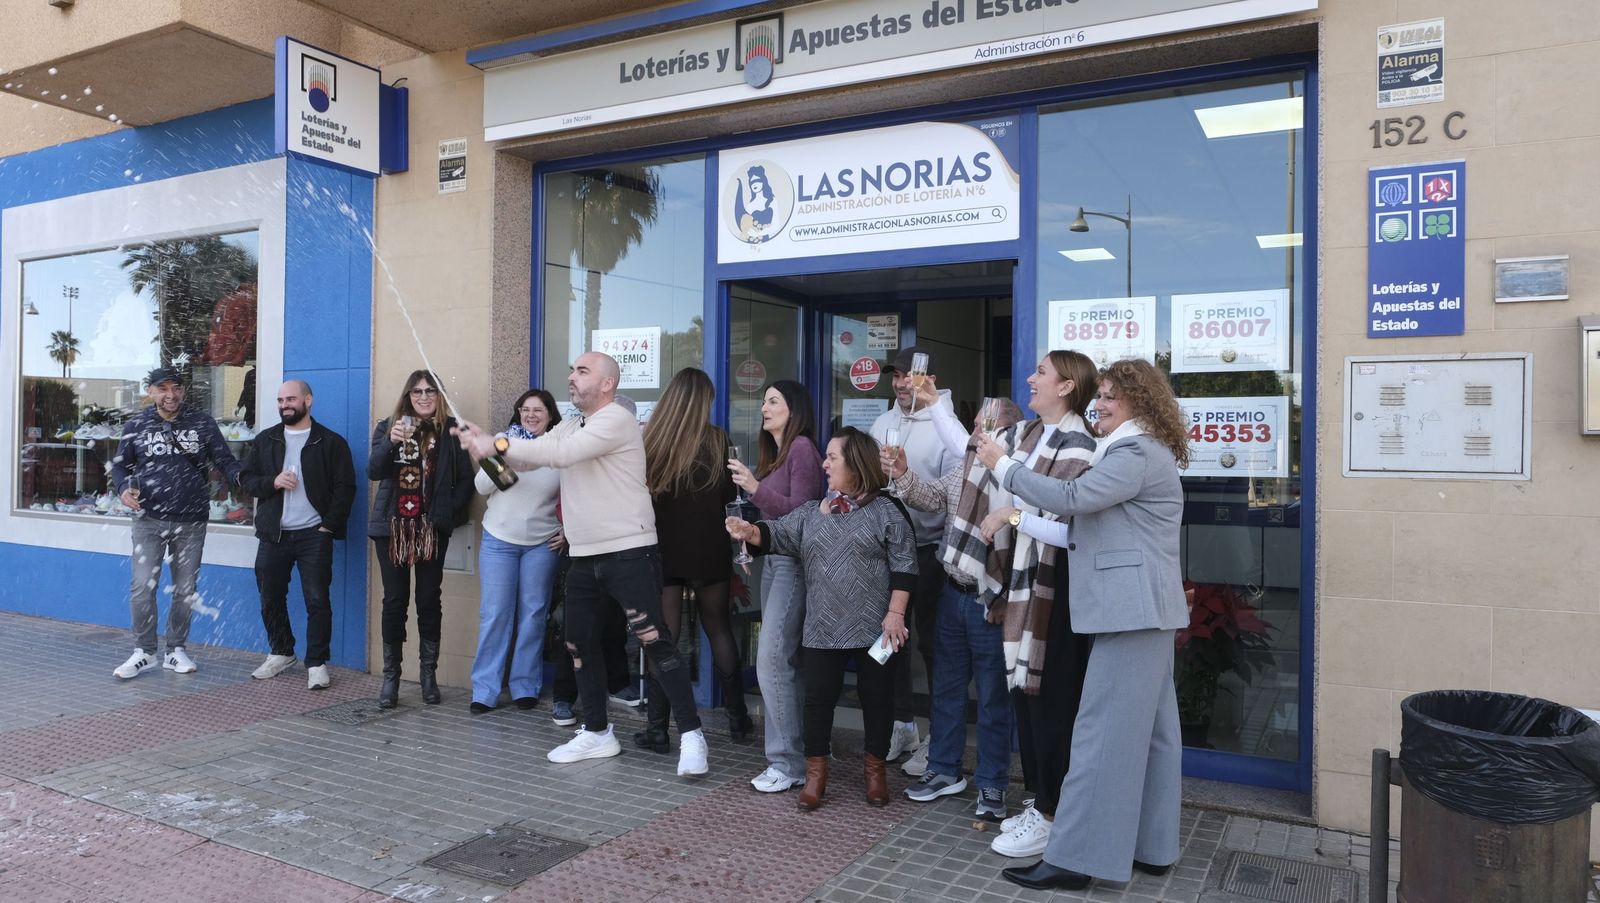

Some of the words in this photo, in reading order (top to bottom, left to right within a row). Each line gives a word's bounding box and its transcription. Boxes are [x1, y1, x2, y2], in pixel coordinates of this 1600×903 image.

[619, 49, 709, 84] Loterías
[716, 47, 730, 73] y
[789, 13, 912, 55] Apuestas
[922, 0, 965, 28] del
[975, 0, 1081, 20] Esta
[974, 35, 1060, 59] Administración
[1382, 52, 1439, 69] Alarma
[301, 110, 340, 131] Loterías
[342, 125, 347, 135] y
[562, 114, 572, 125] Las
[573, 114, 592, 124] Norias
[301, 124, 345, 145] Apuestas
[347, 137, 361, 149] del
[1369, 115, 1428, 149] 152
[1443, 111, 1468, 140] C
[301, 136, 334, 153] Estado
[797, 192, 892, 215] ADMINISTRACIÓN
[895, 192, 910, 204] DE
[913, 186, 963, 202] LOTERÍA
[794, 211, 980, 237] WWW.ADMINISTRACIONLASNORIAS.COM
[1372, 281, 1428, 295] Loterías
[1432, 281, 1441, 295] y
[1081, 309, 1135, 321] PREMIO
[1207, 306, 1265, 319] PREMIO
[1372, 299, 1435, 315] Apuestas
[1438, 297, 1460, 310] del
[1063, 321, 1140, 341] 88979
[1188, 318, 1271, 340] 86007
[1372, 318, 1419, 331] Estado
[602, 339, 649, 352] 94974
[855, 360, 873, 372] +18
[1206, 411, 1265, 422] PREMIO
[1188, 424, 1272, 443] 45353
